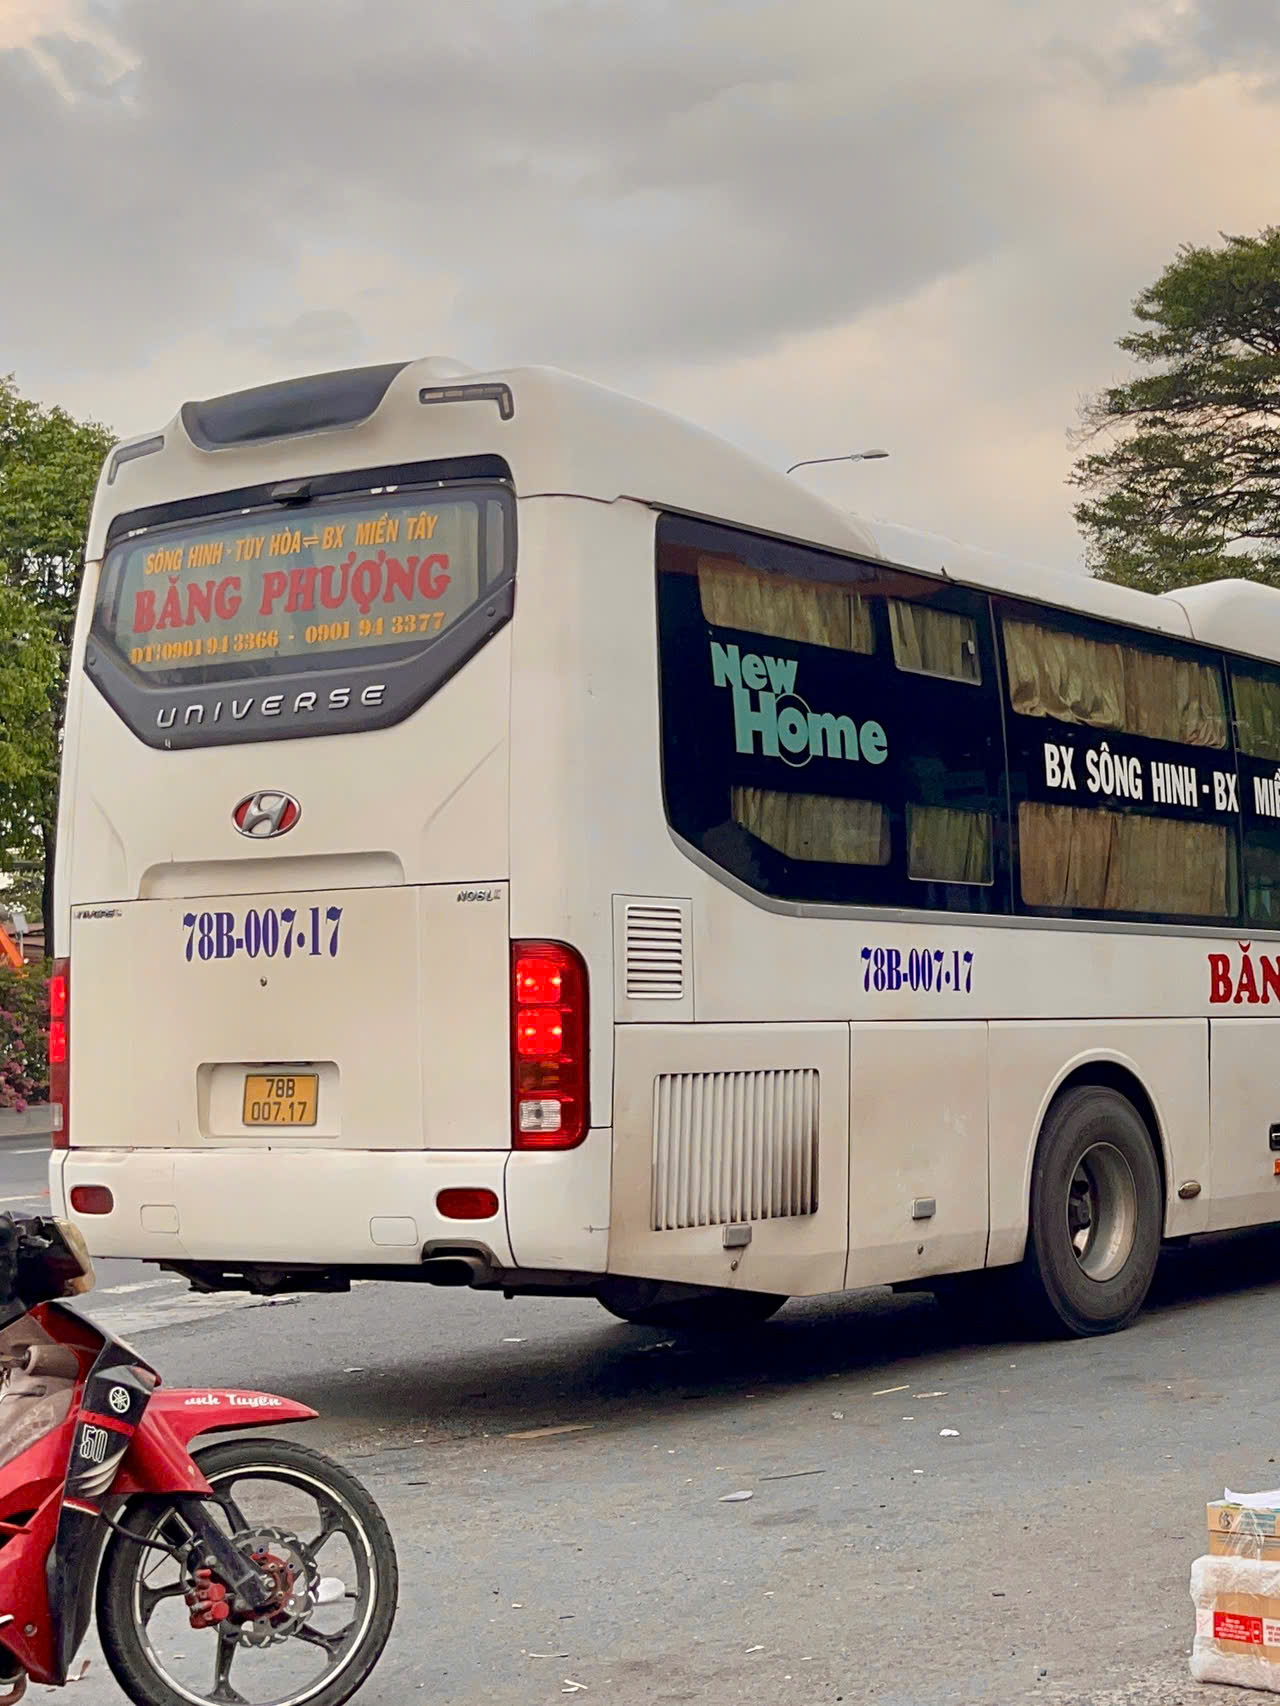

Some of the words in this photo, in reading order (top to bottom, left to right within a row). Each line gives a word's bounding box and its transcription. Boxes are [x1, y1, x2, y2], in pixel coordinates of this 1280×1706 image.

[145, 546, 184, 575] SÔNG
[187, 541, 224, 568] HINH
[236, 536, 265, 561] TUY
[269, 526, 302, 556] HÒA
[322, 525, 346, 549] BX
[355, 512, 400, 546] MIỀN
[408, 511, 438, 541] TÂY
[132, 573, 242, 633] BĂNG
[259, 548, 452, 616] PHƯỢNG
[391, 612, 446, 634] 3377
[710, 641, 798, 694] New
[156, 684, 386, 729] UNIVERSE
[732, 687, 888, 766] Home
[1043, 743, 1077, 791] BX
[1086, 742, 1142, 800] SÔNG
[1151, 761, 1198, 807] HINH
[1213, 772, 1239, 813] BX
[250, 1100, 308, 1123] 007.17
[264, 1077, 296, 1099] 78B
